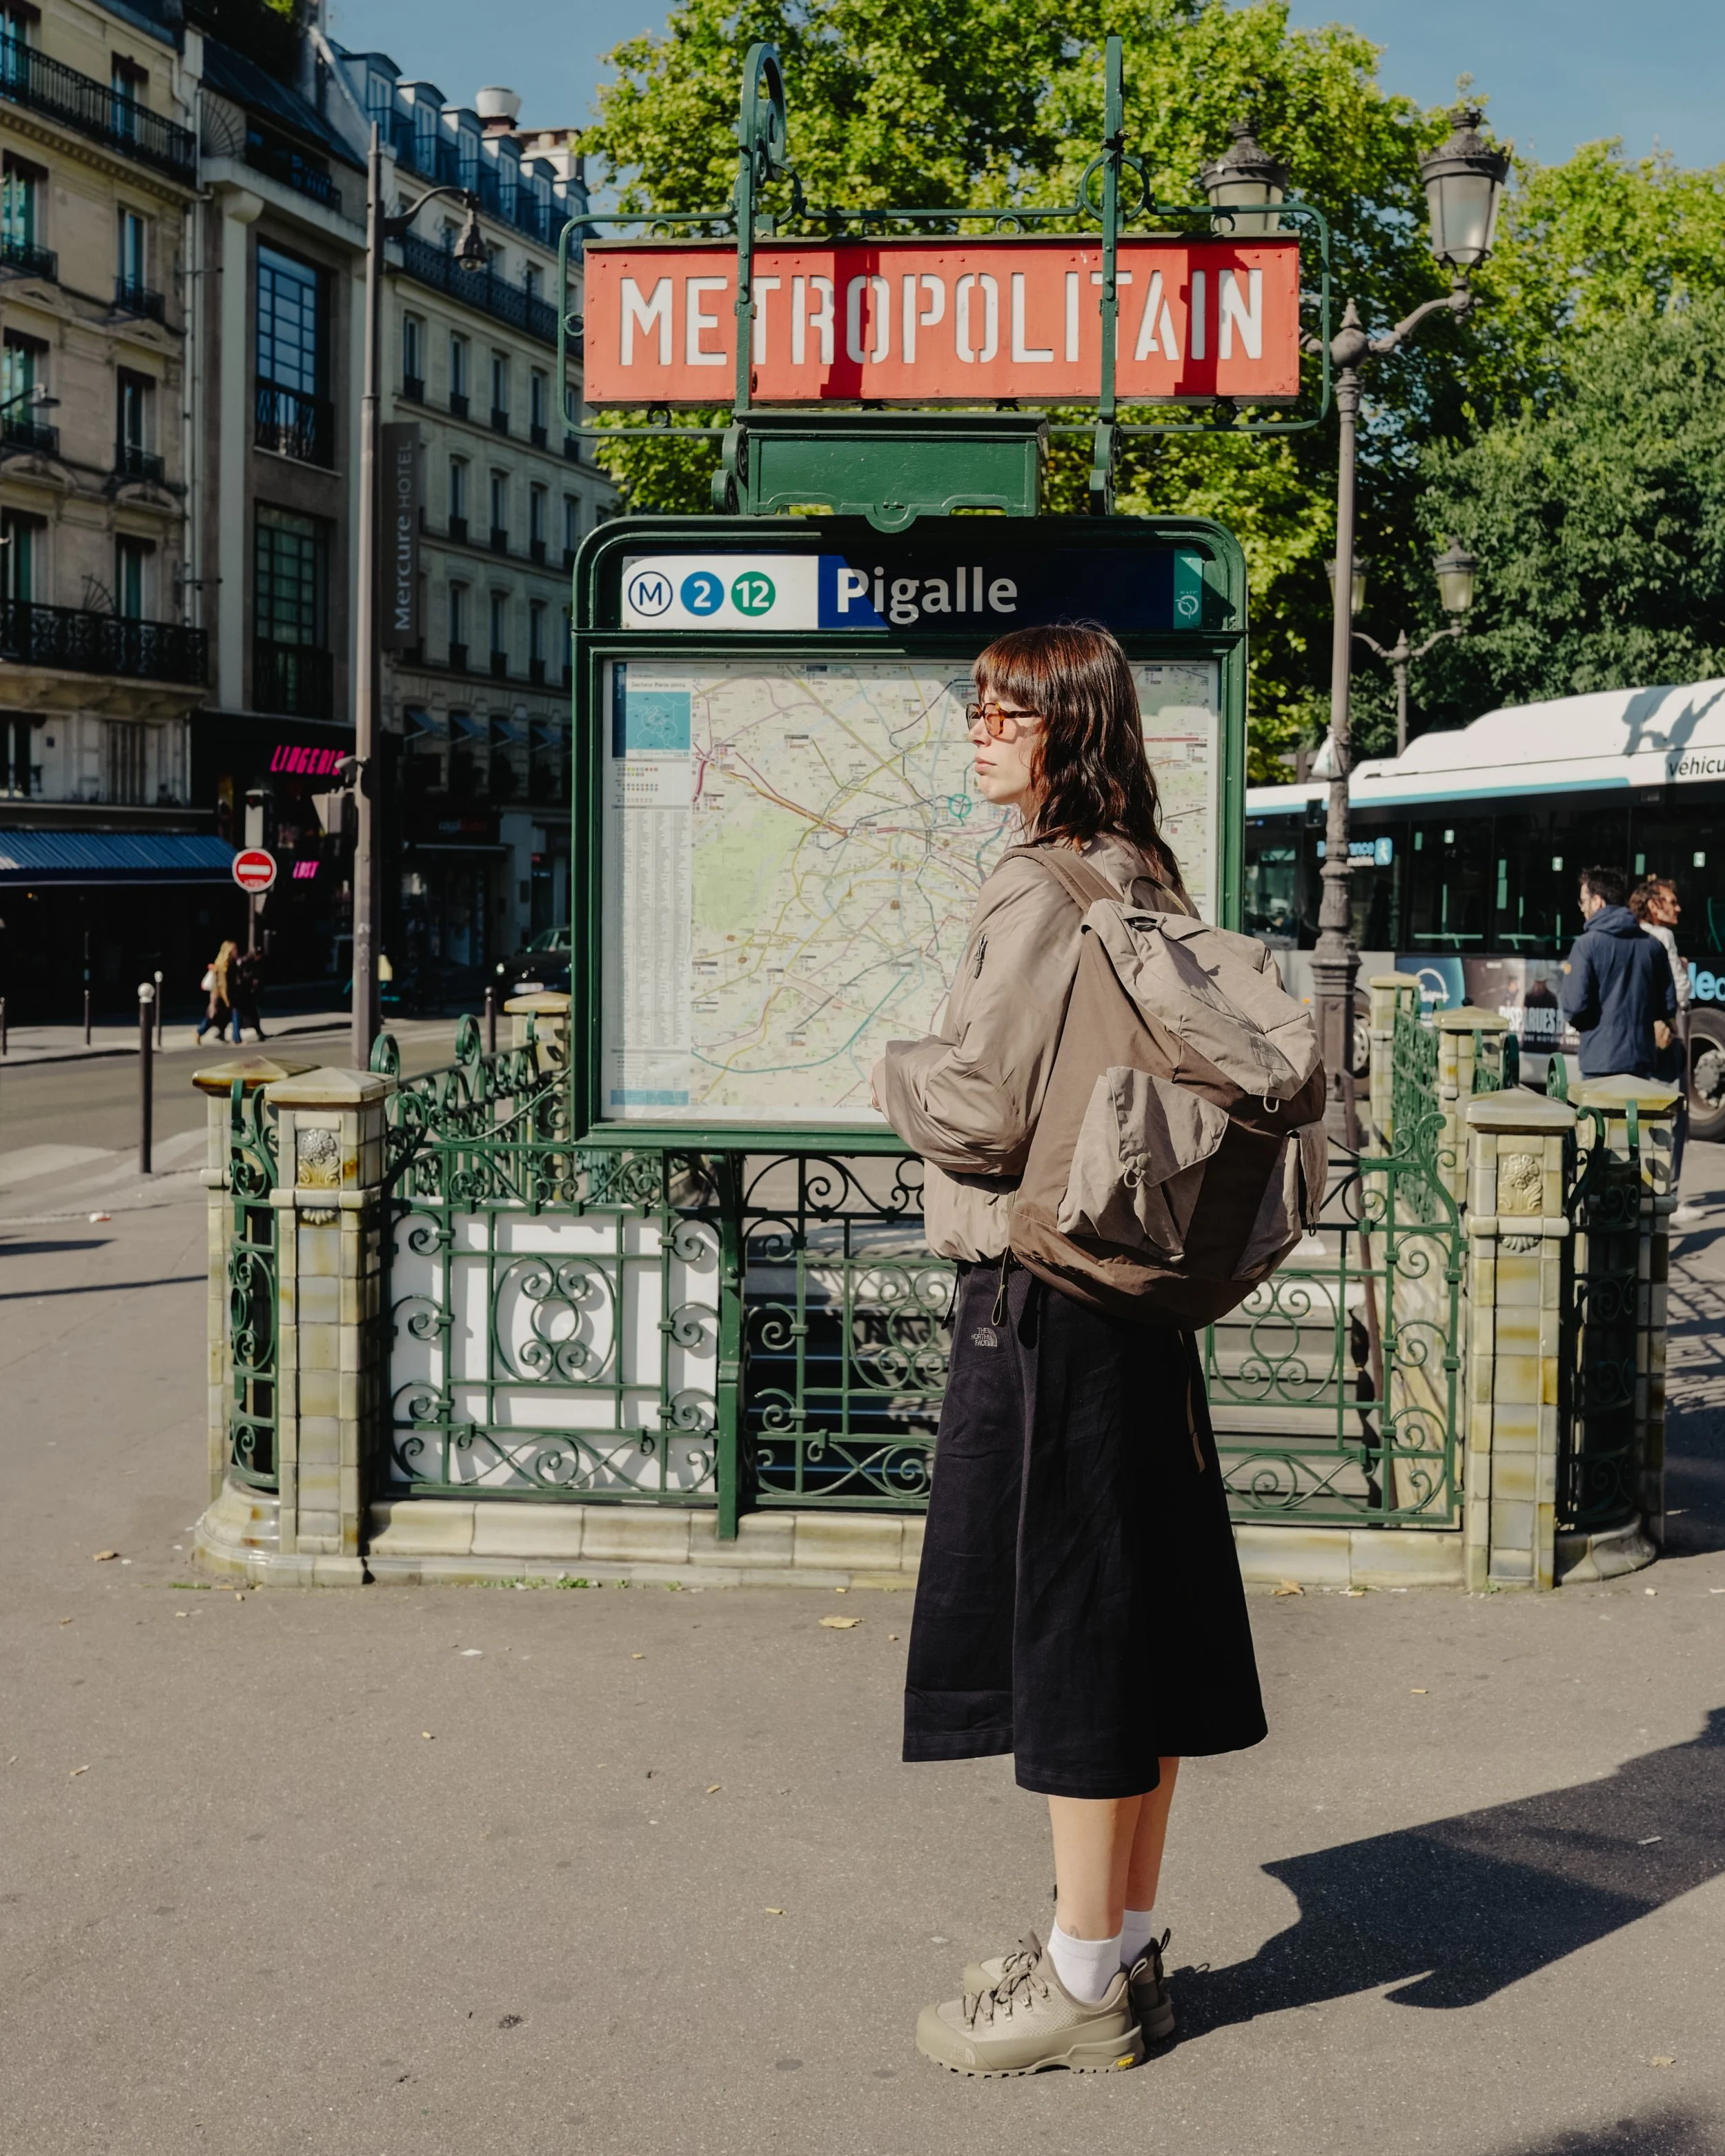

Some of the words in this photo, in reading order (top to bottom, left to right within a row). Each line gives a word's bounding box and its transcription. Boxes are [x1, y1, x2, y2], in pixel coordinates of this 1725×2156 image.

[397, 439, 411, 509] HOTEL
[394, 515, 411, 630] Mercure
[639, 582, 662, 606] M
[693, 581, 711, 608] 2
[736, 581, 770, 608] 12
[837, 566, 1018, 624] Pigalle
[1669, 755, 1725, 777] véhicu
